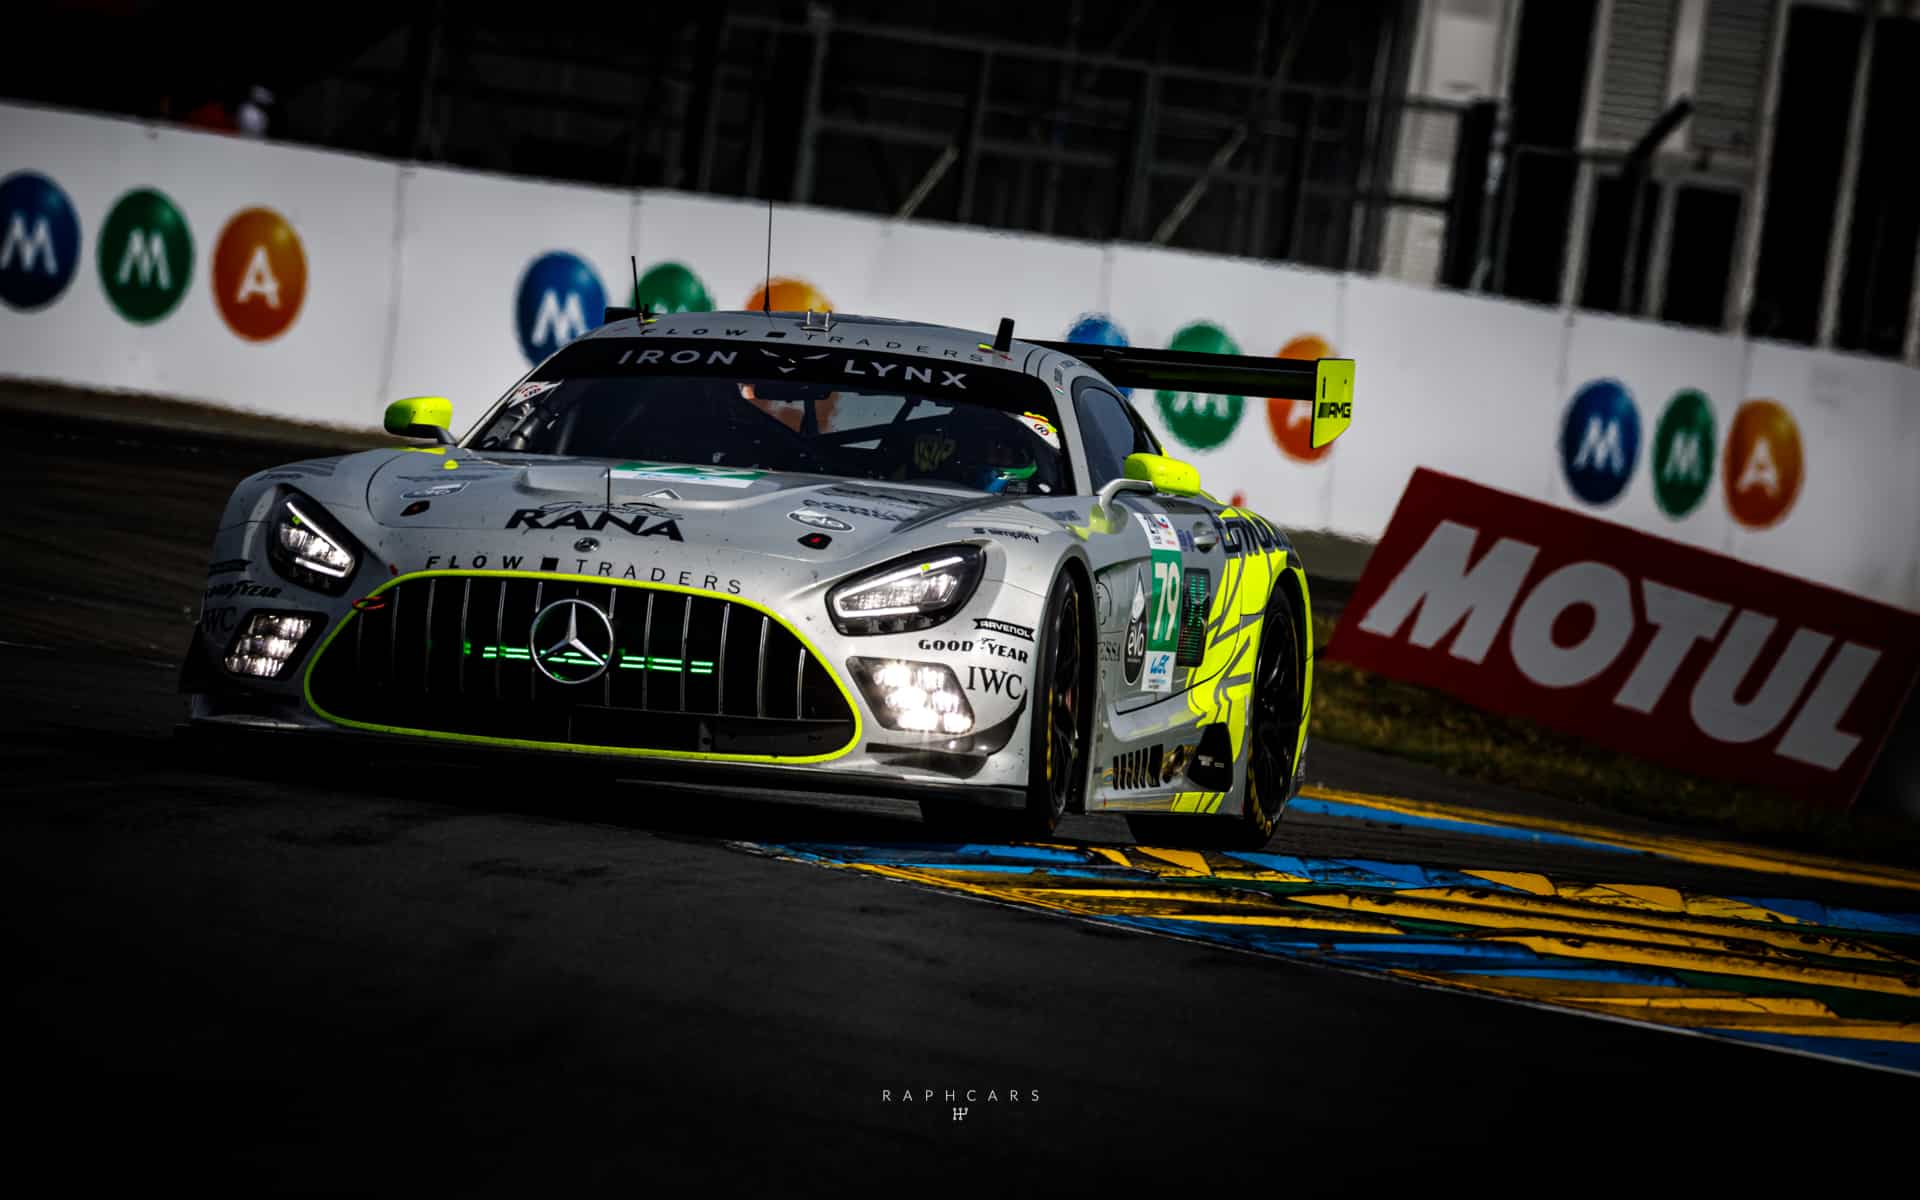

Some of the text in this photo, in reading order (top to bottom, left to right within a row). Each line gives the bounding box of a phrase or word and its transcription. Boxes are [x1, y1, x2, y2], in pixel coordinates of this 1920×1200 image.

[641, 328, 986, 363] FLOW TRADERS
[615, 349, 969, 390] IRON LYNX
[505, 508, 684, 543] RANA
[426, 555, 742, 595] FLOW TRADERS
[1151, 561, 1180, 641] 79
[1357, 517, 1882, 772] MOTUL
[966, 665, 1023, 700] IWC
